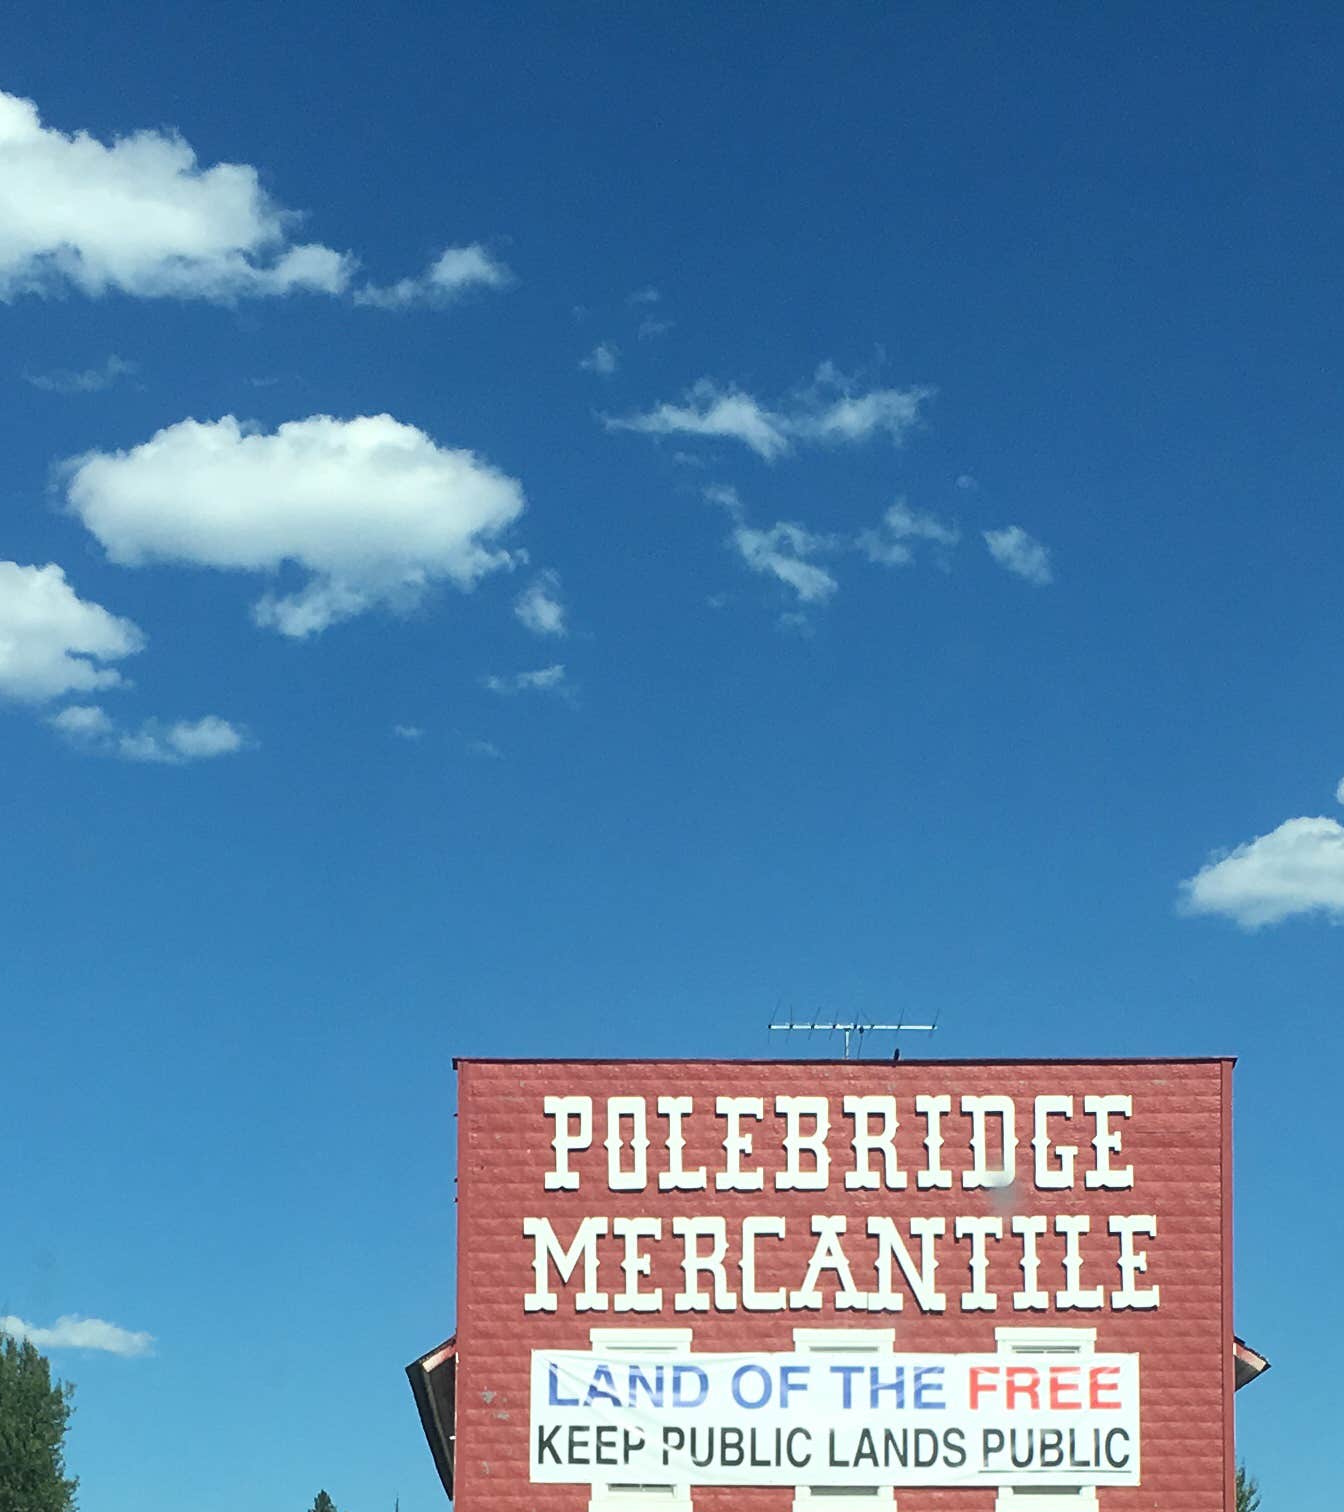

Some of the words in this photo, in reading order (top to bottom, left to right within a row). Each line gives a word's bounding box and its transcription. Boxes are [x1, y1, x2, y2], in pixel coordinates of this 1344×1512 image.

[543, 1095, 1135, 1191] POLEBRIDGE
[523, 1215, 1161, 1313] MERCANTILE
[548, 1362, 710, 1409] LAND
[731, 1364, 812, 1410] OF
[829, 1365, 947, 1411] THE
[968, 1365, 1123, 1412] FREE
[537, 1424, 646, 1466] KEEP
[661, 1425, 813, 1469] PUBLIC
[828, 1426, 968, 1469] LANDS
[981, 1426, 1131, 1470] PUBLIC
